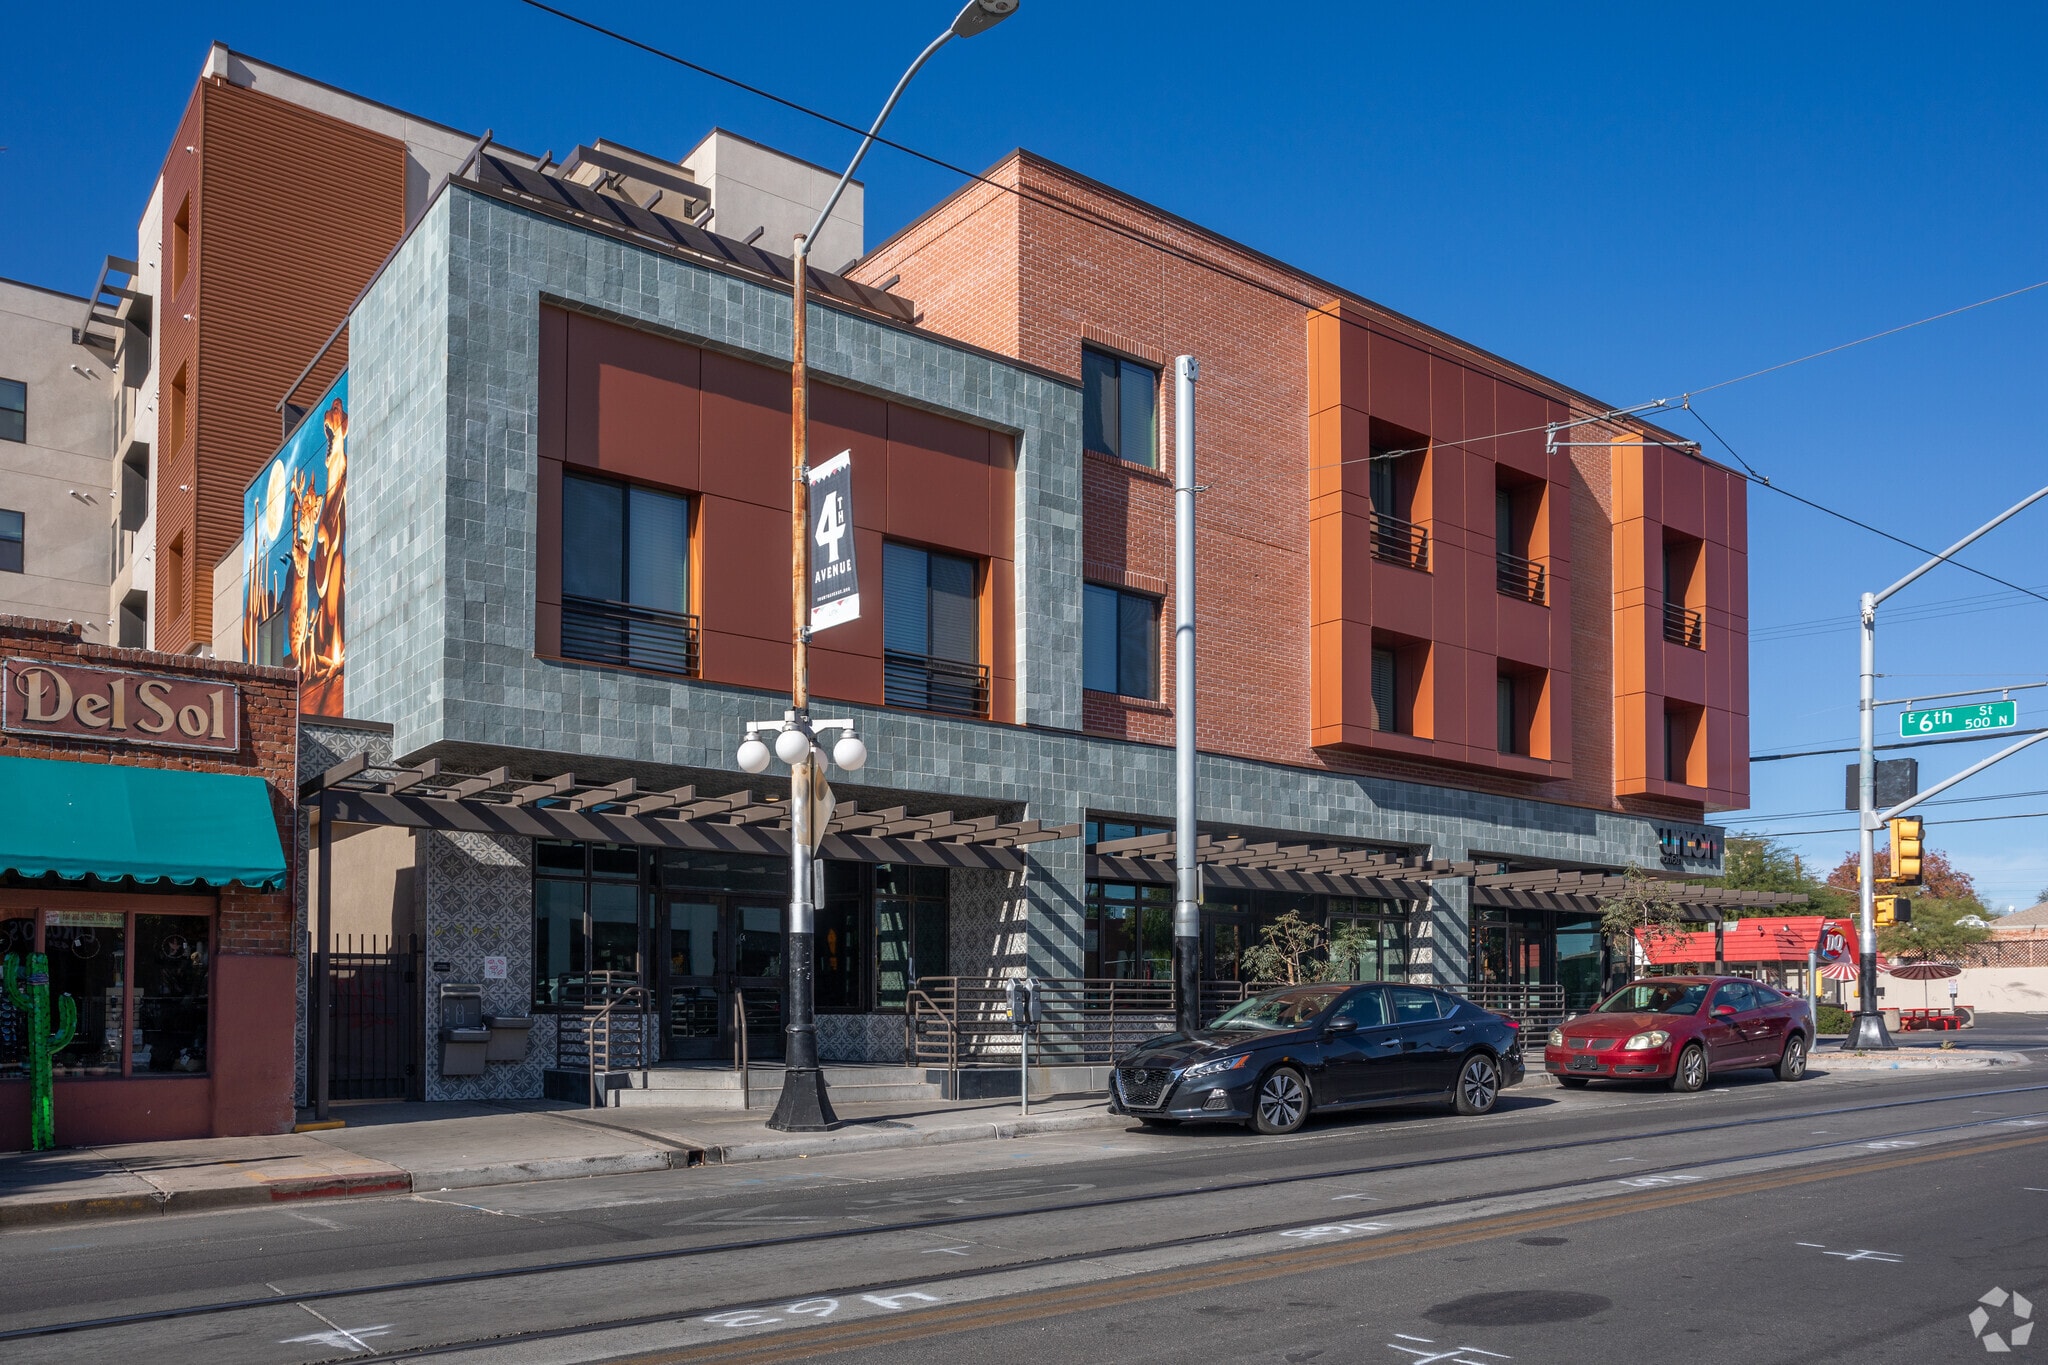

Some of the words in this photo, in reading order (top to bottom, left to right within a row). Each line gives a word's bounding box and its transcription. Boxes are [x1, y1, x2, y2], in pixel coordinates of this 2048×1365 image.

[815, 559, 852, 584] AVENUE
[15, 666, 127, 729] Del
[134, 680, 226, 739] Sol
[1908, 713, 1915, 724] E
[1920, 710, 1953, 732] 6th
[1979, 705, 1993, 716] St
[1965, 717, 1991, 729] 500
[1999, 715, 2008, 725] N
[1826, 934, 1844, 953] DQ
